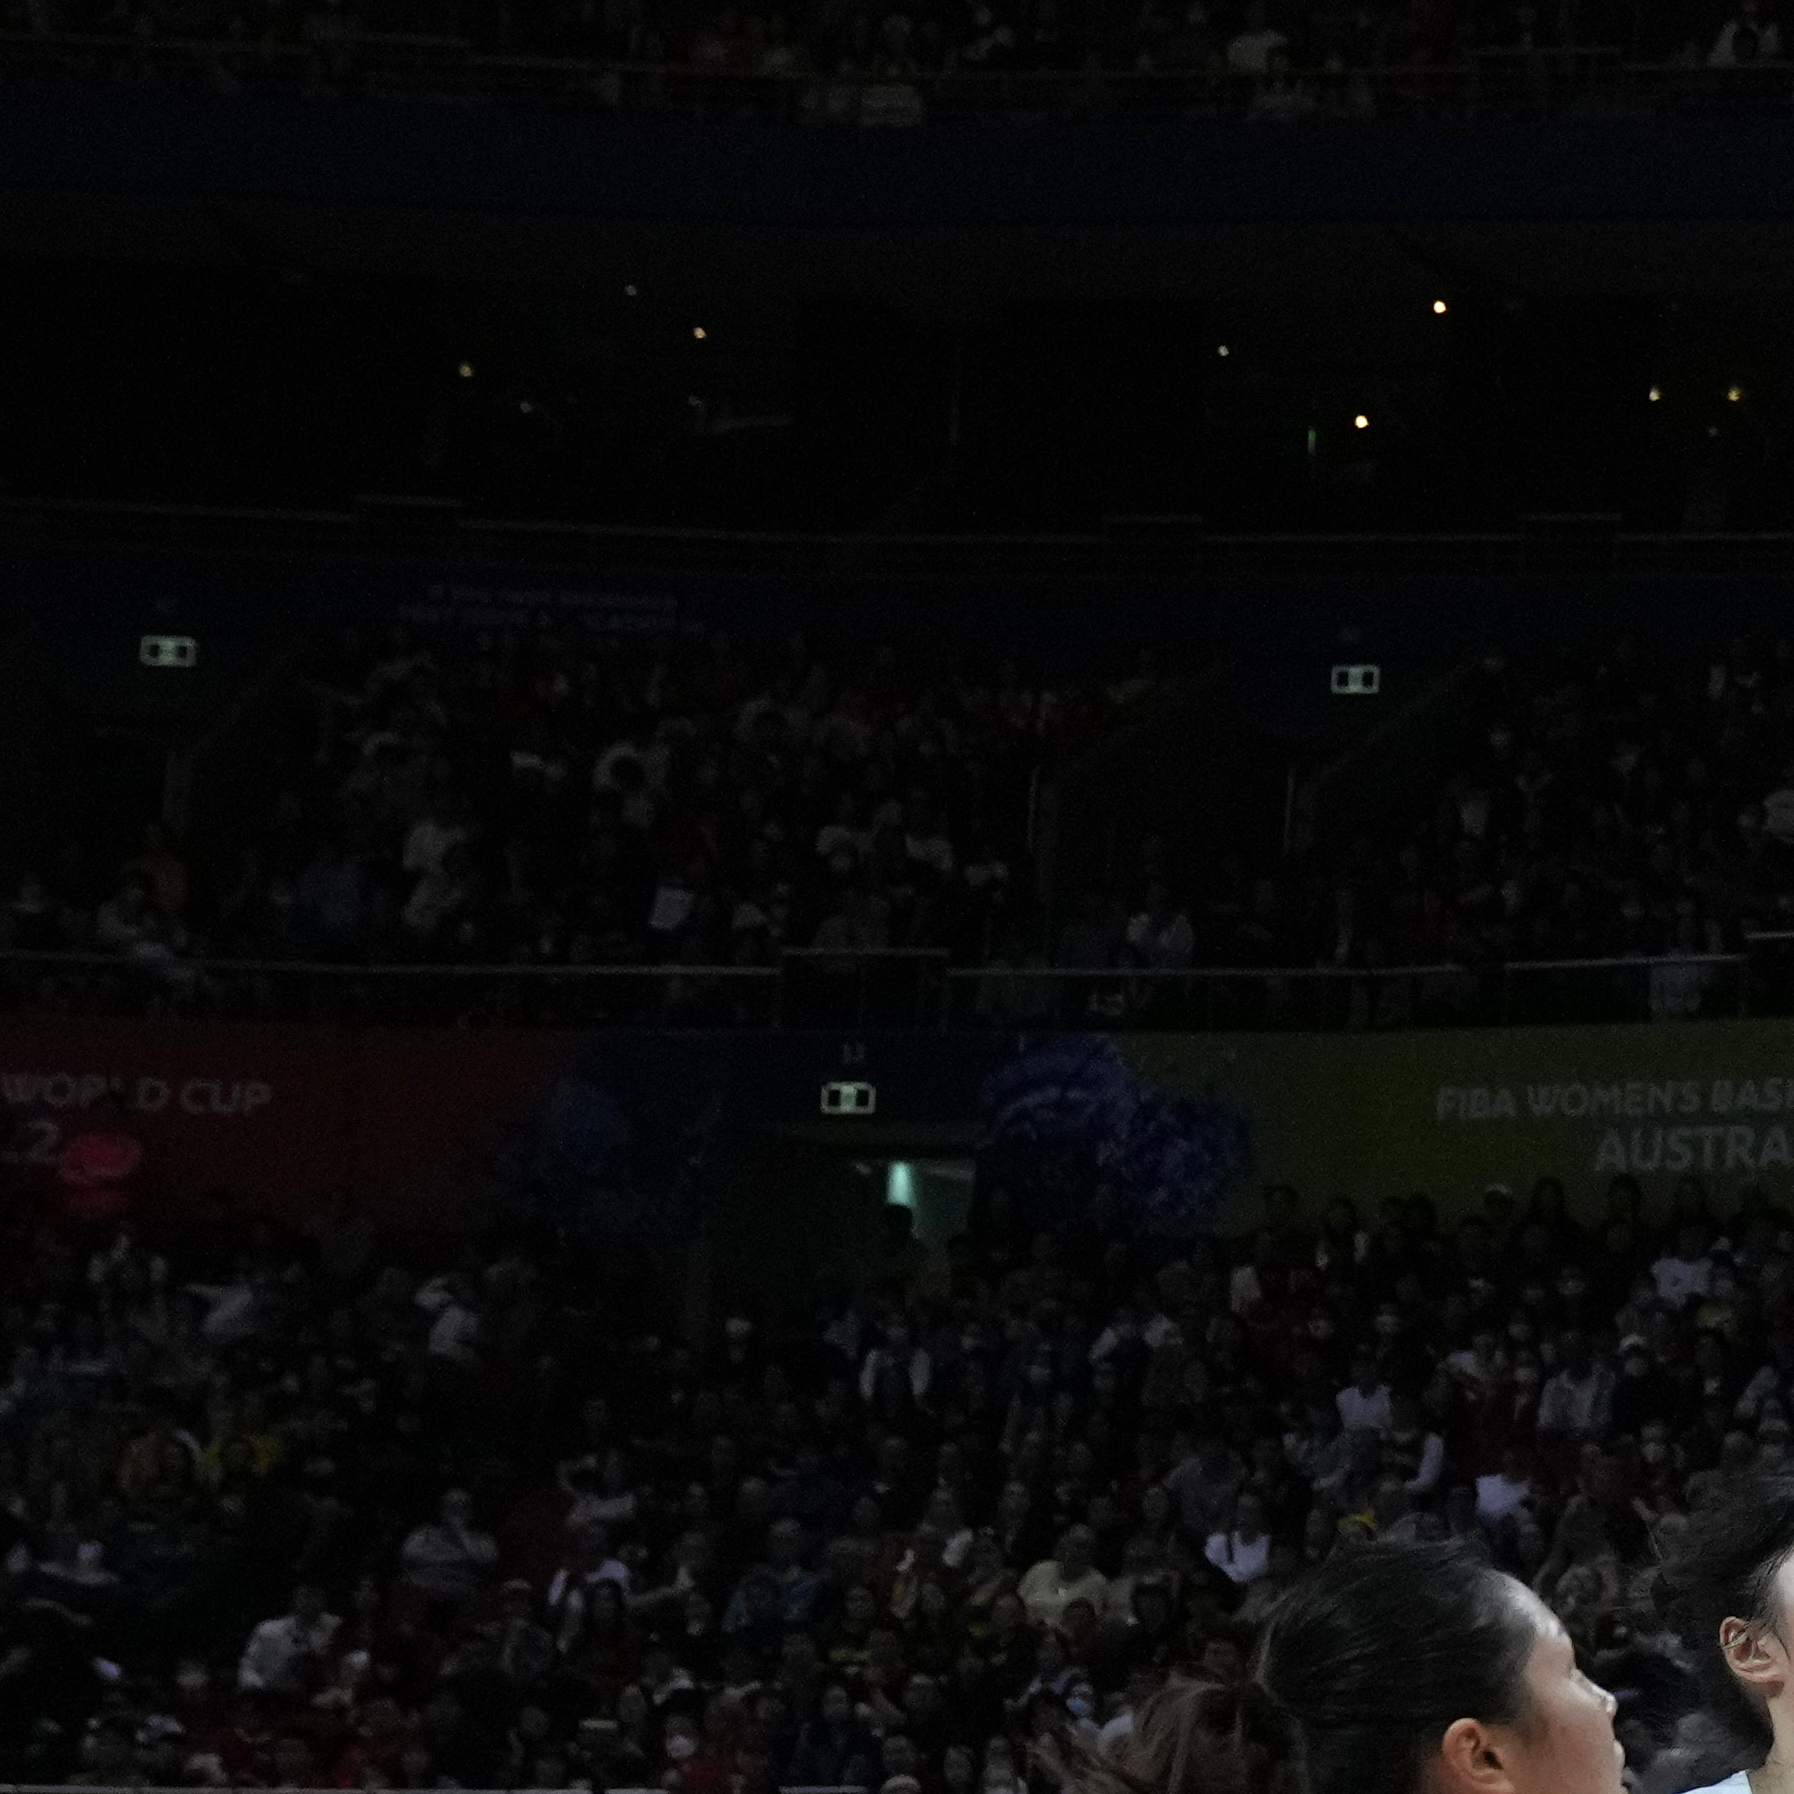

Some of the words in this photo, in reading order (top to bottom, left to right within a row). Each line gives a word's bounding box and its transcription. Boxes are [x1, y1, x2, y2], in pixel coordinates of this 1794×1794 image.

[179, 1077, 273, 1117] CUP
[1435, 1085, 1517, 1122] FIBA
[1526, 1079, 1701, 1119] WOMEN'S
